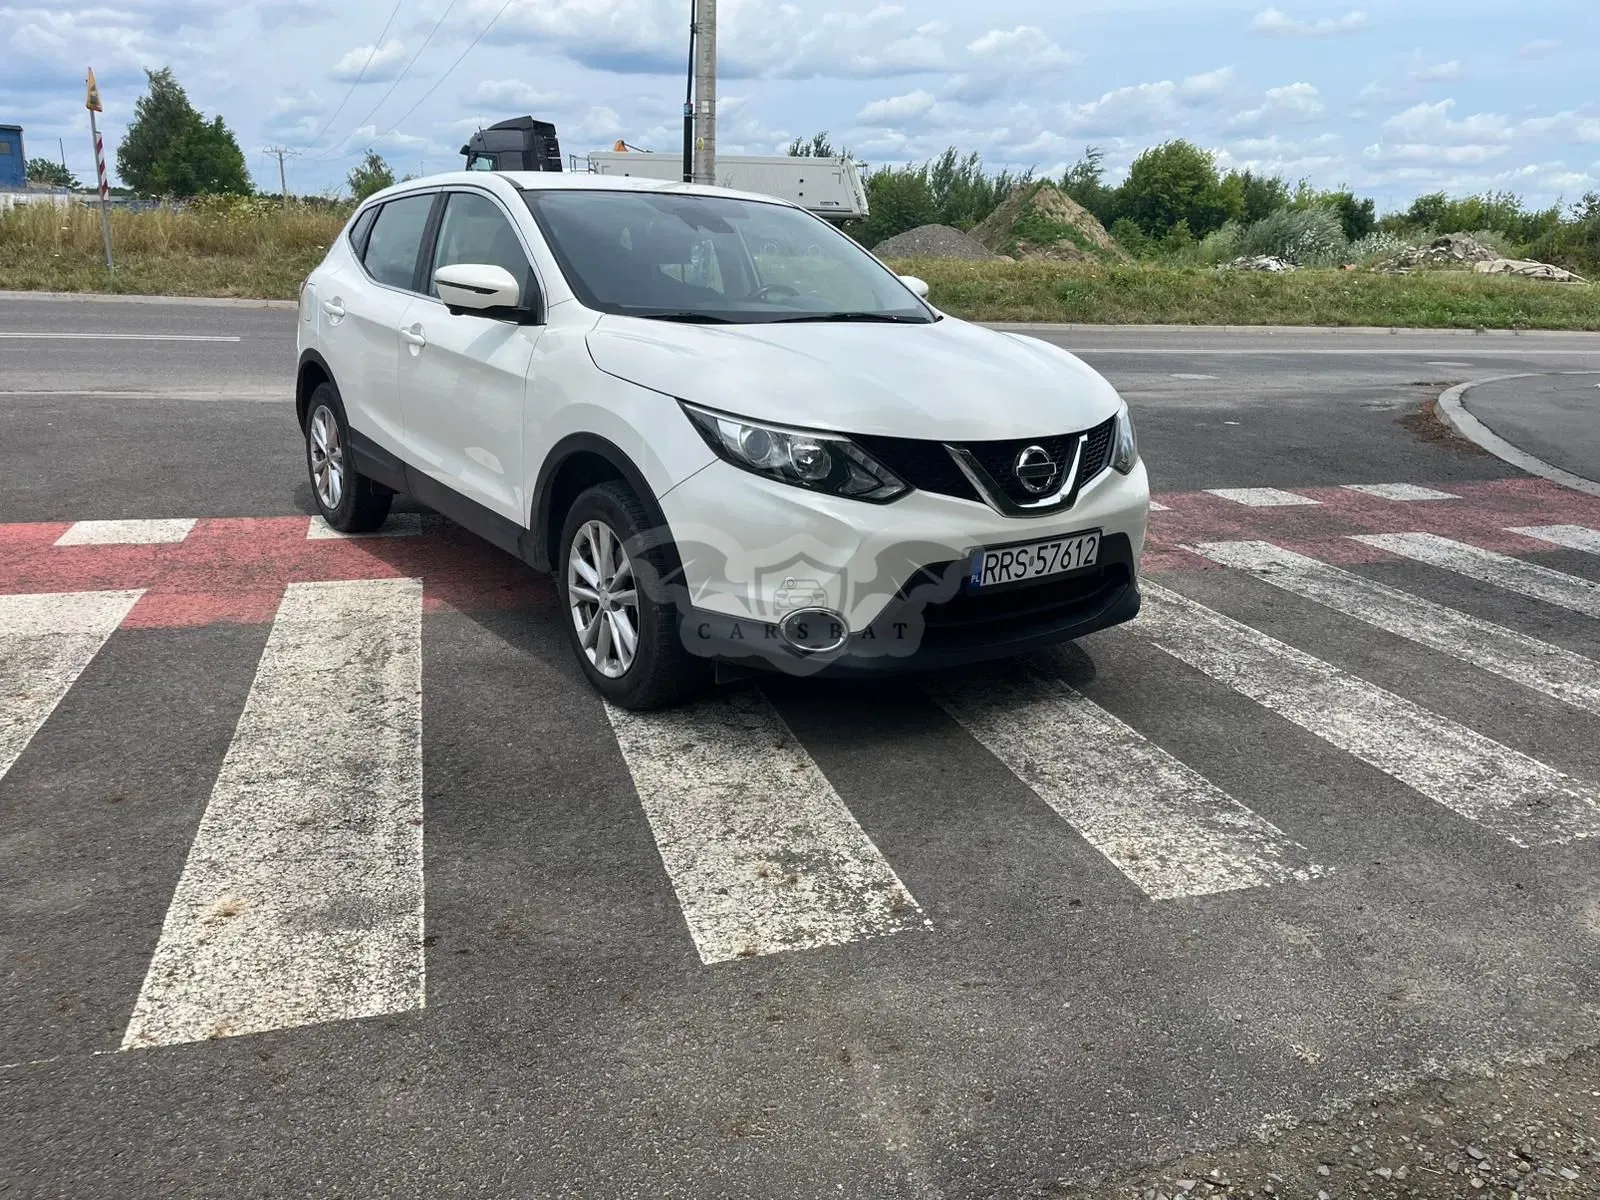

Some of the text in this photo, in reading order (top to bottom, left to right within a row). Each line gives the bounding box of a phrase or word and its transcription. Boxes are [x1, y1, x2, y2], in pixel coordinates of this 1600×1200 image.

[983, 536, 1097, 584] RRS 57612
[970, 574, 980, 583] PL
